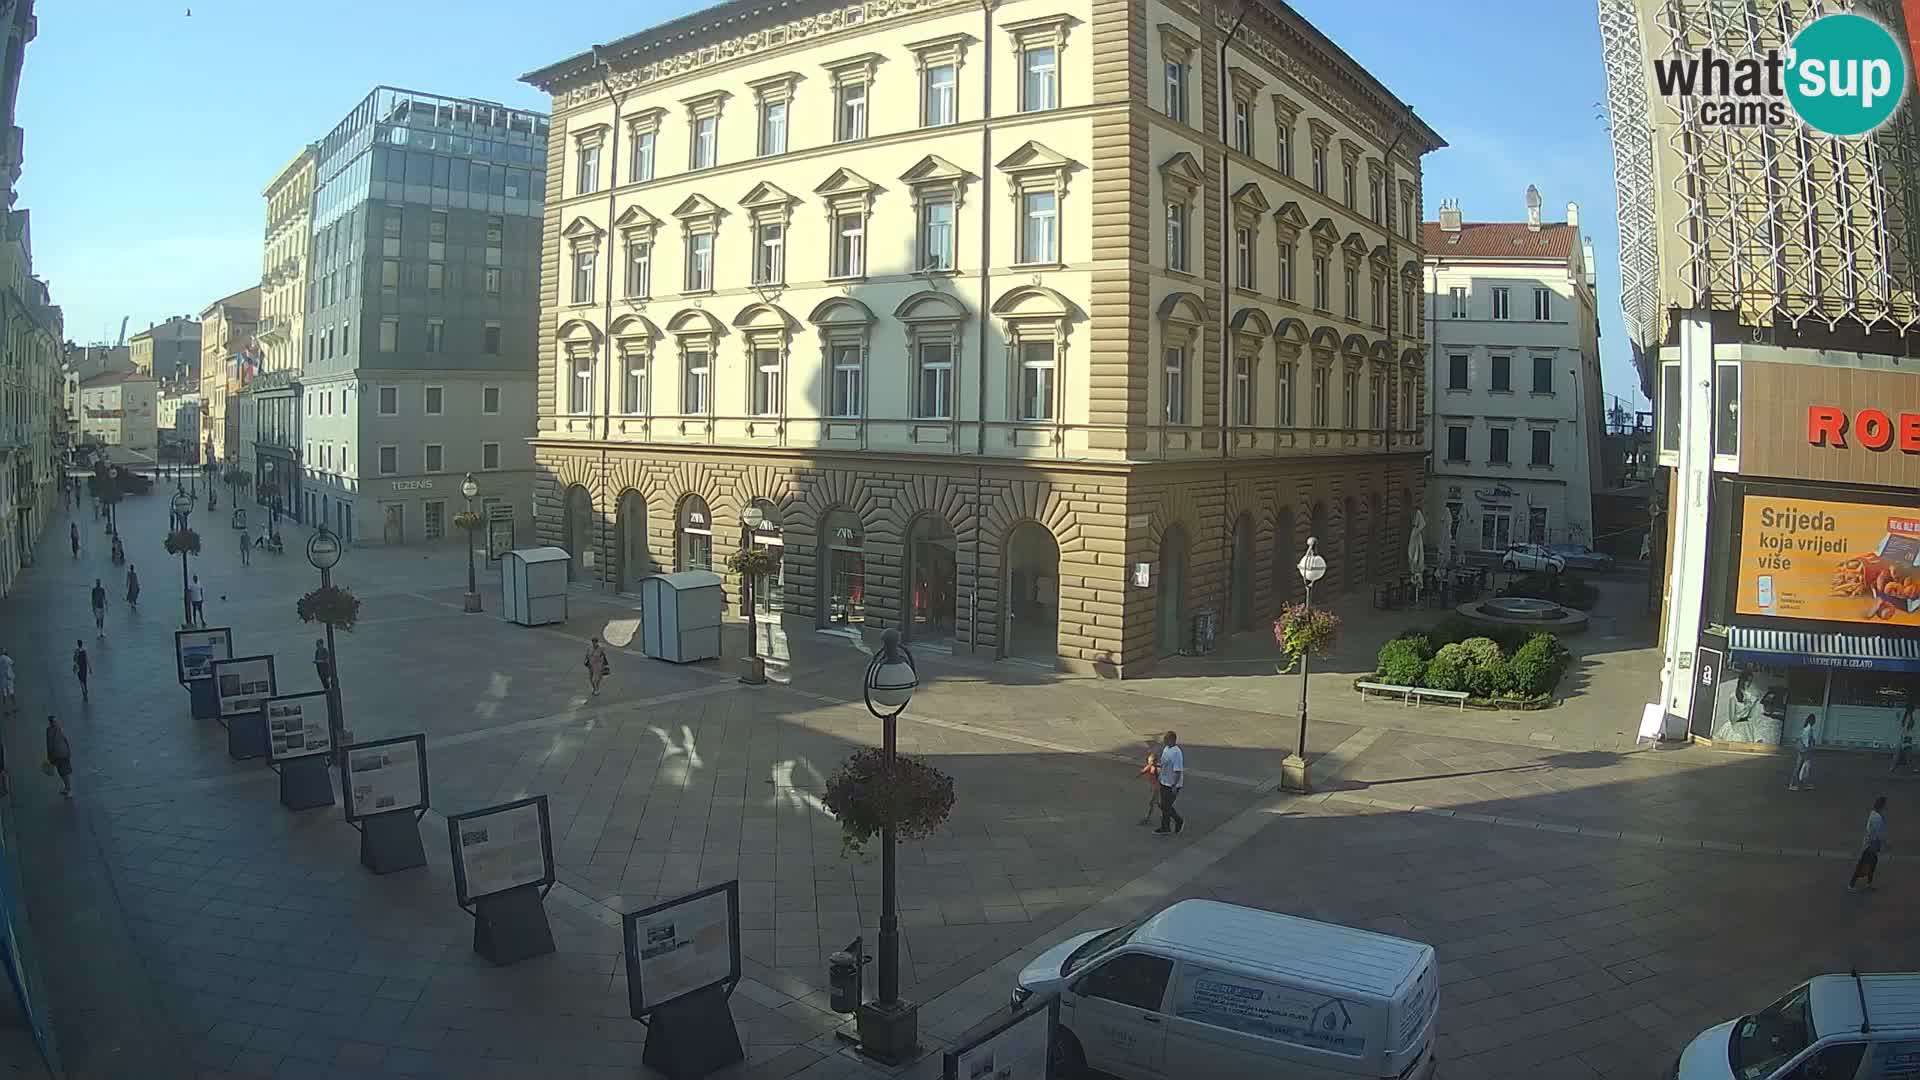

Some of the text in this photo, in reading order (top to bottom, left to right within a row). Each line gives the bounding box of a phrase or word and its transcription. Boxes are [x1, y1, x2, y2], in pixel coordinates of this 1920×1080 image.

[392, 479, 432, 490] TEZENIS
[1761, 506, 1835, 534] Srijeda
[1759, 532, 1848, 556] koja vrijedi
[1758, 553, 1792, 570] više
[1849, 659, 1873, 668] GELATO
